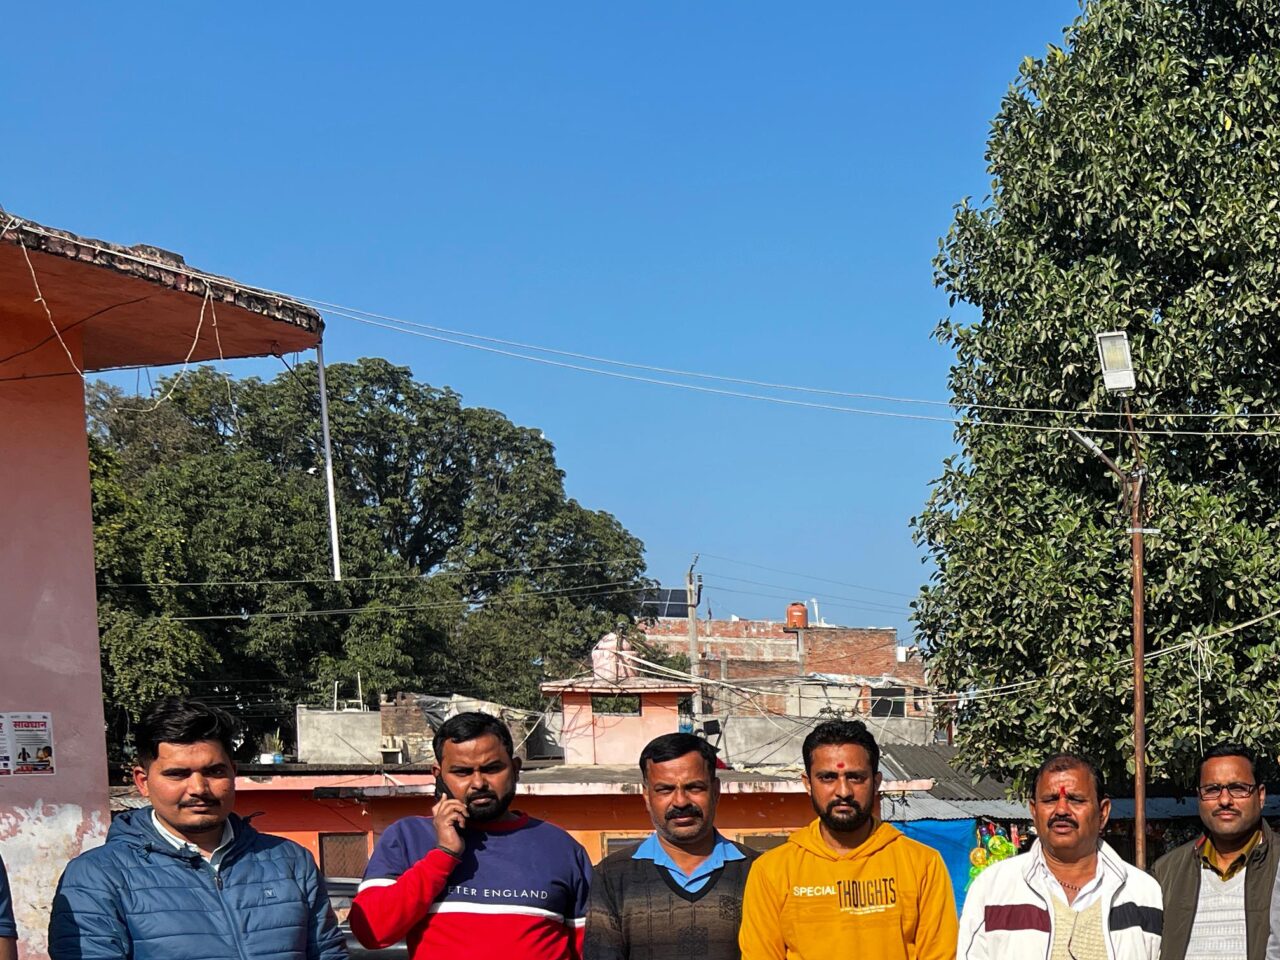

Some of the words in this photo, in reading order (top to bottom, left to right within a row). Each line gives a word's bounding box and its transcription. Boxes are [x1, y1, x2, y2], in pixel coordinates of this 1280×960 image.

[447, 885, 477, 896] ETER
[484, 889, 548, 899] ENGLAND
[793, 886, 837, 896] SPECIAL
[837, 878, 896, 908] THOUGHTS
